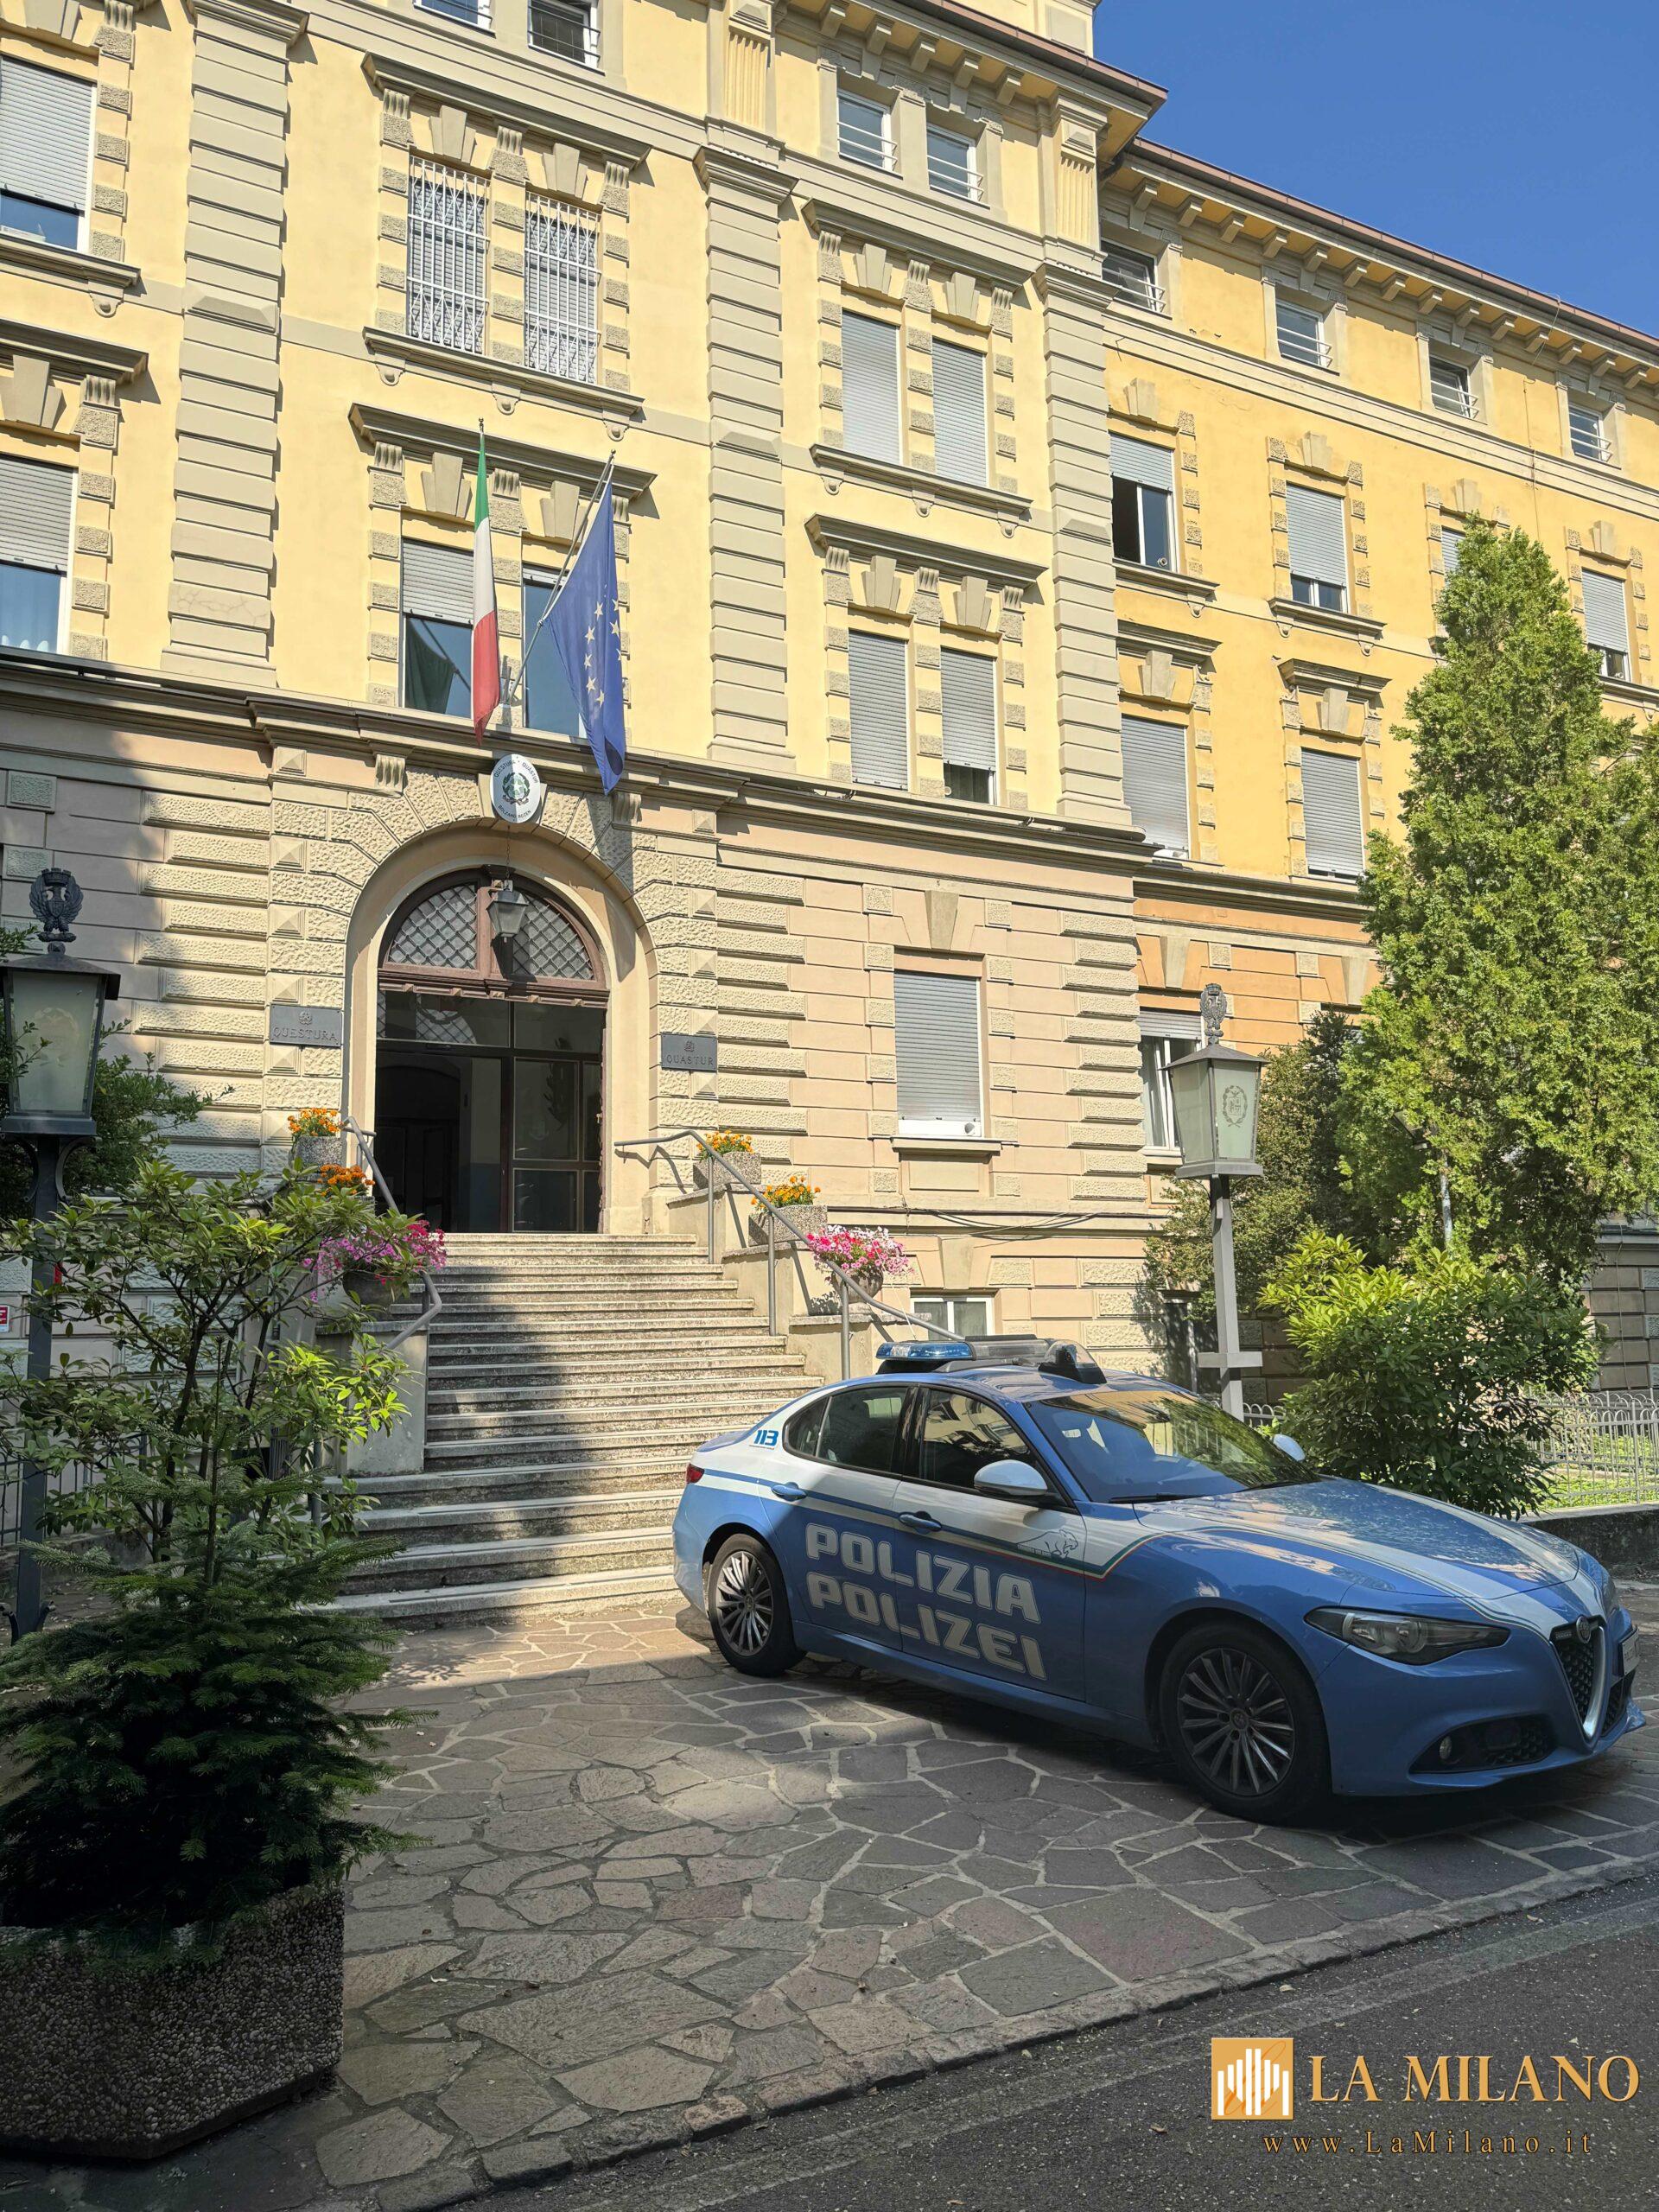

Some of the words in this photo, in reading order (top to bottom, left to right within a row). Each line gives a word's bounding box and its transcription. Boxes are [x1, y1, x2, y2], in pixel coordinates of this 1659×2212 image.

[273, 1027, 337, 1041] QUESTURA
[753, 1429, 779, 1446] 113
[805, 1523, 1041, 1624] POLIZIA
[806, 1572, 1047, 1681] POLIZEI
